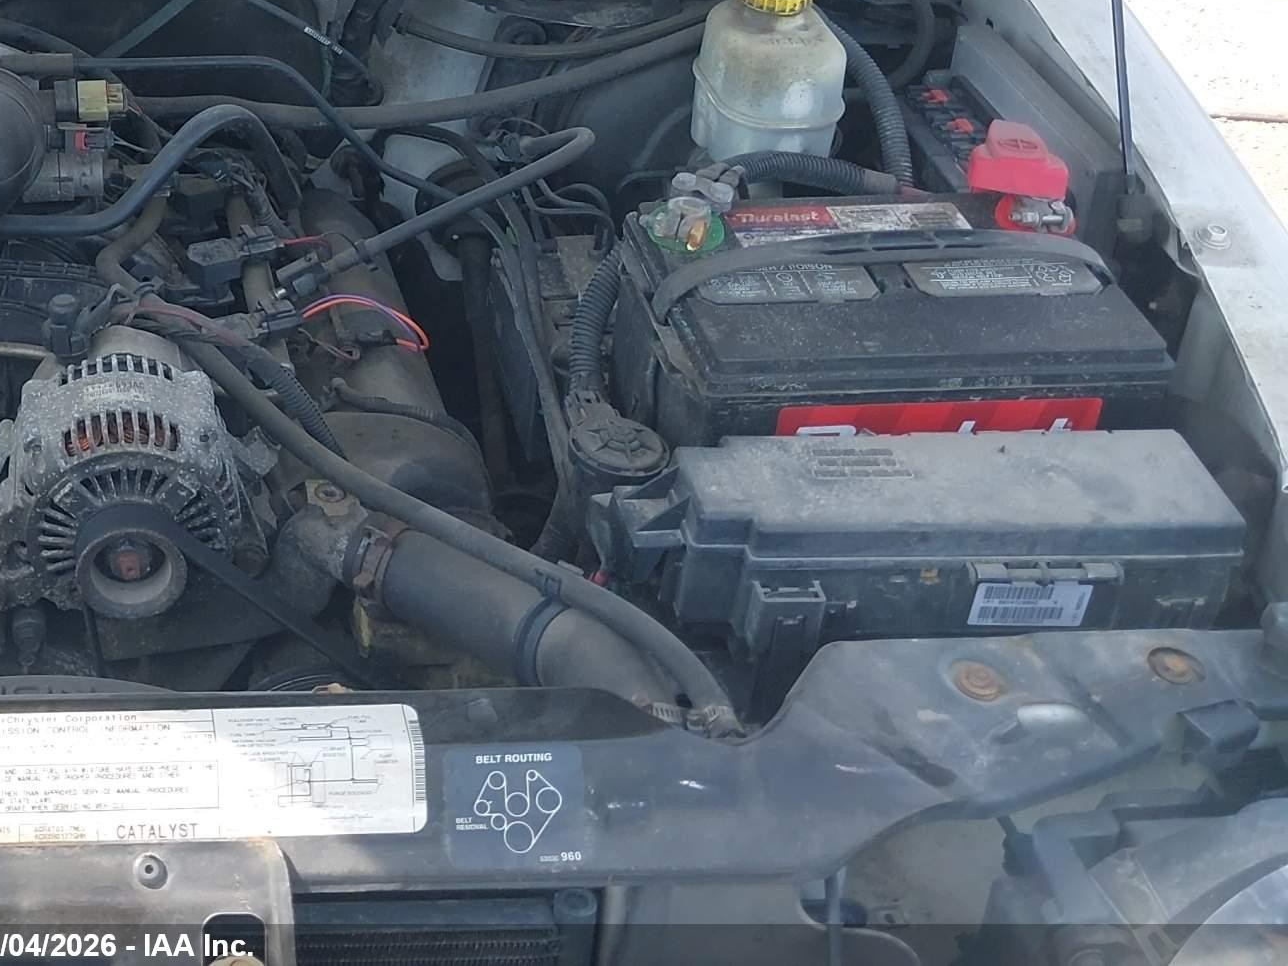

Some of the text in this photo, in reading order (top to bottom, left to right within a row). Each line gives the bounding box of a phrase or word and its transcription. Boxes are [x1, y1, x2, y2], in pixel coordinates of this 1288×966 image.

[65, 713, 137, 725] Corporation
[100, 722, 171, 732] NFORMATION
[475, 752, 553, 764] BELT ROUTING
[116, 822, 199, 839] CATALYST
[560, 851, 582, 862] 960
